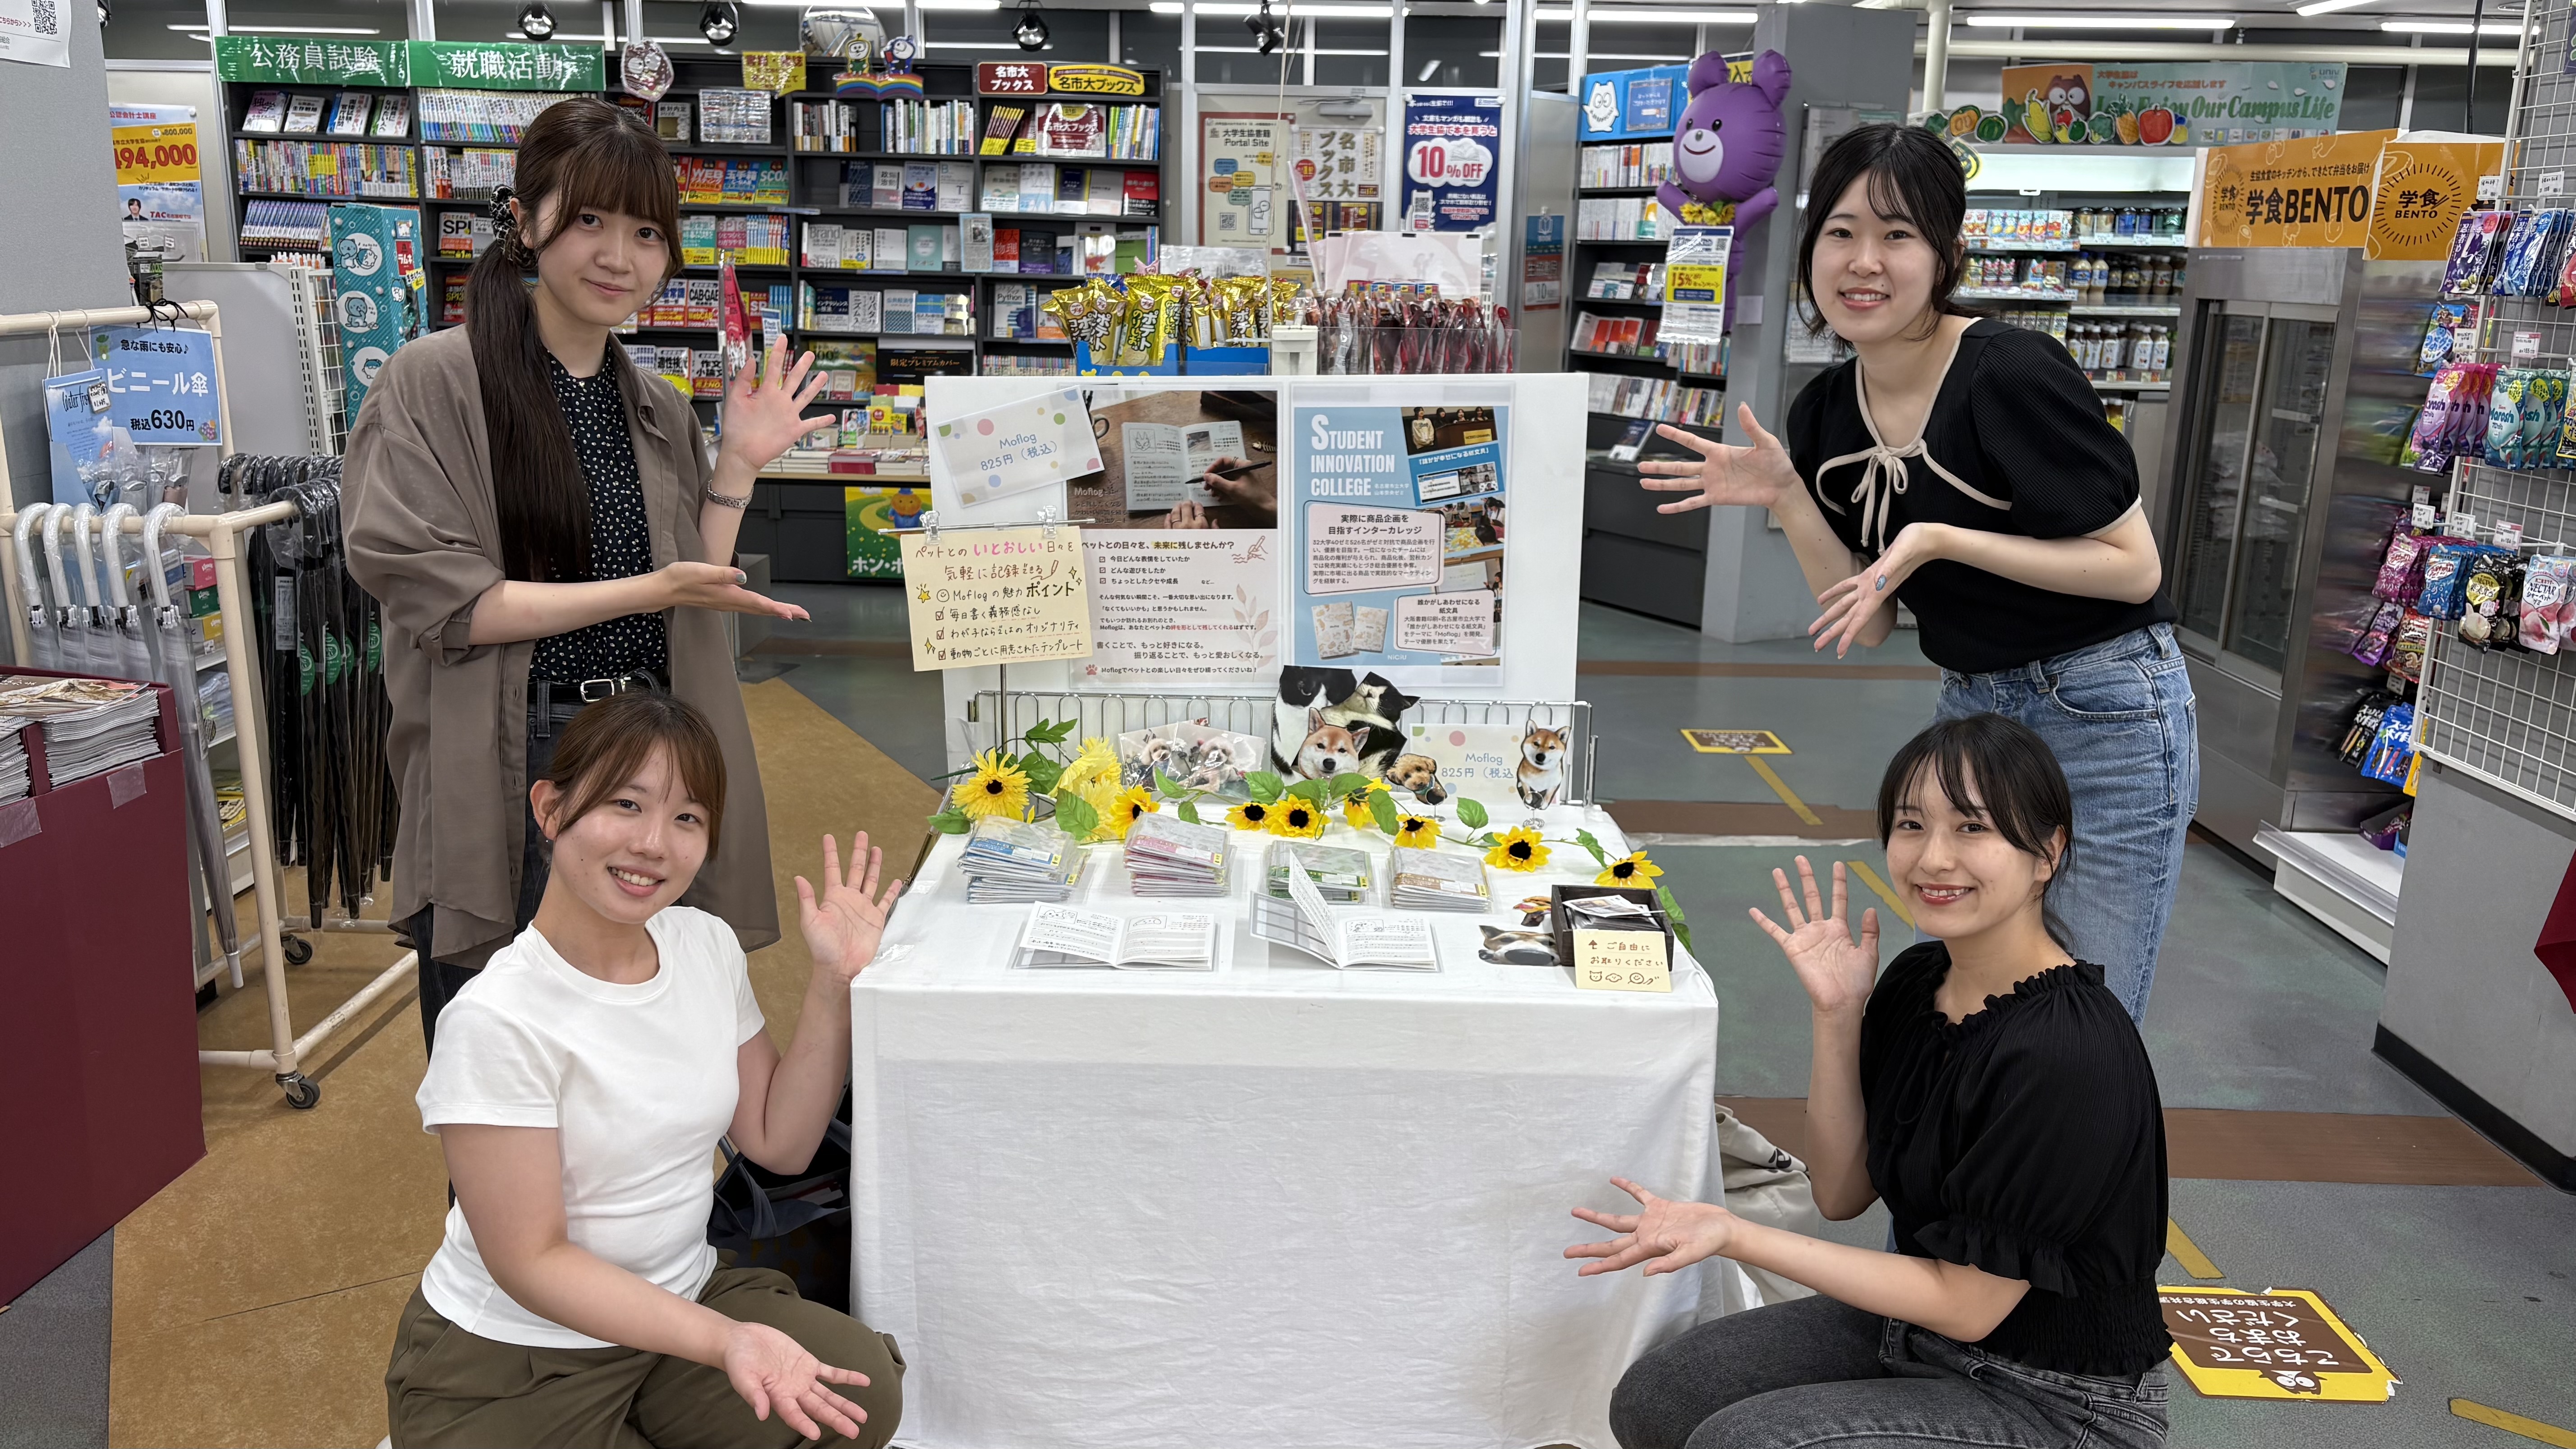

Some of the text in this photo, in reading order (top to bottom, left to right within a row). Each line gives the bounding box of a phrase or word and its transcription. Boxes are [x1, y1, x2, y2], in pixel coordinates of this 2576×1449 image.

[250, 43, 380, 72] 公務員試験
[450, 50, 566, 80] 就職活動
[995, 65, 1029, 78] 名市大
[990, 79, 1034, 91] ブックス
[1058, 76, 1136, 93] 名市大ブックス
[2108, 80, 2227, 89] キャンパスライフを応援します
[2191, 96, 2228, 119] Our
[2228, 96, 2300, 124] Campus
[2301, 96, 2335, 120] Life
[1223, 129, 1271, 138] 大学生協書籍
[1408, 124, 1497, 137] 大学生協で本を買うと
[1224, 138, 1270, 147] Portal Site
[1317, 130, 1336, 198] ブックス
[1337, 131, 1356, 198] 名市大
[1417, 146, 1484, 179] 10% OFF
[693, 169, 724, 179] WEB
[725, 170, 759, 181] 玉手箱
[760, 170, 789, 182] SCOA
[2220, 186, 2236, 202] 学食
[2398, 189, 2441, 208] 学食
[2245, 184, 2370, 225] 学食BENTO
[2394, 210, 2438, 219] BENTO
[442, 220, 472, 235] SPI
[809, 226, 841, 239] Brand
[995, 243, 1018, 256] 物理
[398, 255, 413, 264] ラムネ
[1671, 272, 1693, 287] 15%
[997, 293, 1023, 303] Python
[1095, 312, 1112, 351] ポテト
[1128, 309, 1144, 345] のりしお
[1140, 309, 1159, 351] ポテト
[658, 357, 688, 369] 適性検
[107, 368, 209, 397] ビニール傘
[130, 409, 195, 431] 税込630円
[1311, 414, 1384, 451] STUDENT
[999, 433, 1038, 449] Moflog
[1311, 455, 1395, 473] INNOVATION
[1311, 478, 1371, 496] COLLEGE
[1341, 515, 1409, 523] 実際に商品企画を
[1329, 526, 1422, 535] 目指すインターカレッジ
[945, 563, 1043, 581] 気軽に記録できる
[2527, 583, 2557, 595] NECTAR
[950, 605, 1041, 622] 毎日書く義務感なし
[950, 620, 1079, 639] わが子ならではのオリジナリティ
[950, 639, 1083, 660] 動物ごとに用意されたテンプレート
[1097, 641, 1205, 649] 書くことで、もっと好きになる。
[1134, 651, 1264, 659] 振り返ることで、もっと愛おしくなる。
[1465, 753, 1503, 766] Moflog
[1441, 767, 1517, 779] 825円（税込
[1607, 941, 1651, 952] ご自由に
[1590, 956, 1664, 966] お取りください
[2176, 1309, 2300, 1327] ください
[2209, 1327, 2307, 1346] おまち
[2209, 1346, 2339, 1366] こちらで
